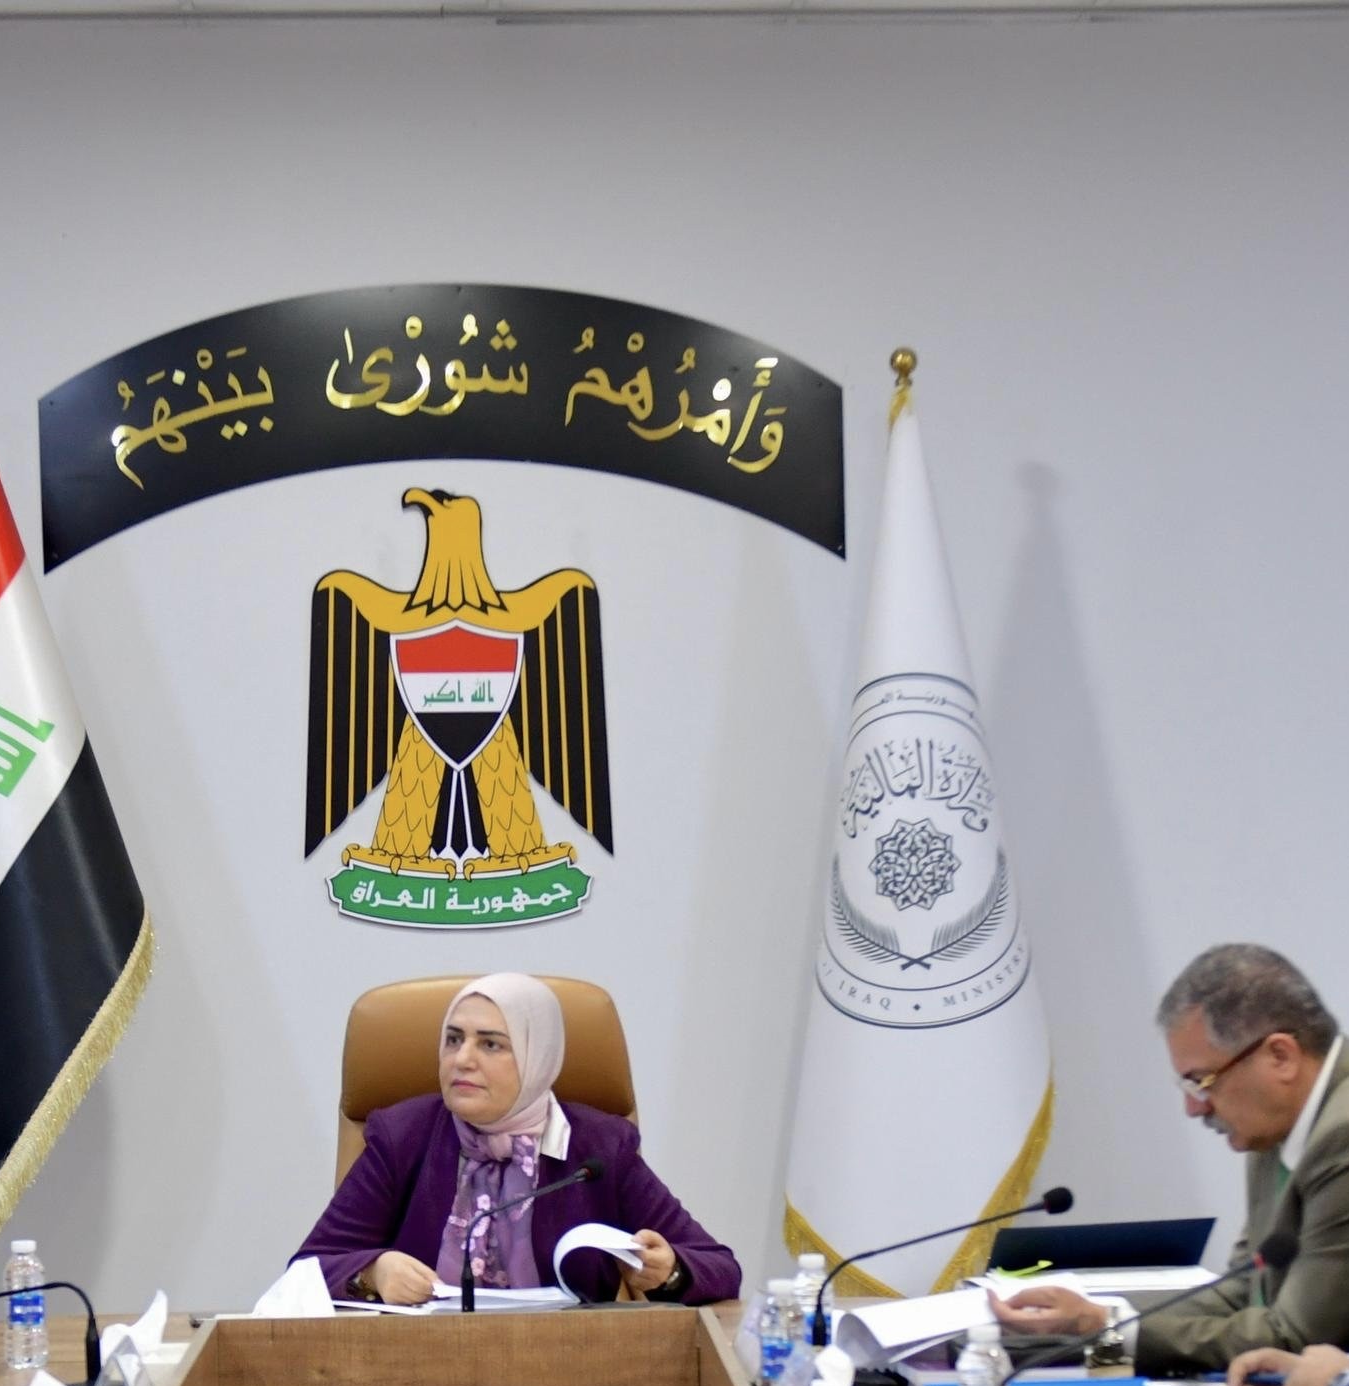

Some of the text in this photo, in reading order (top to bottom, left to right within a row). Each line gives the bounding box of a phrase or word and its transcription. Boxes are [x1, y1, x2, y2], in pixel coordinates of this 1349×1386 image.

[471, 679, 494, 703] الله
[350, 879, 573, 915] جمهورية العراق
[839, 979, 891, 1010] IRAQ
